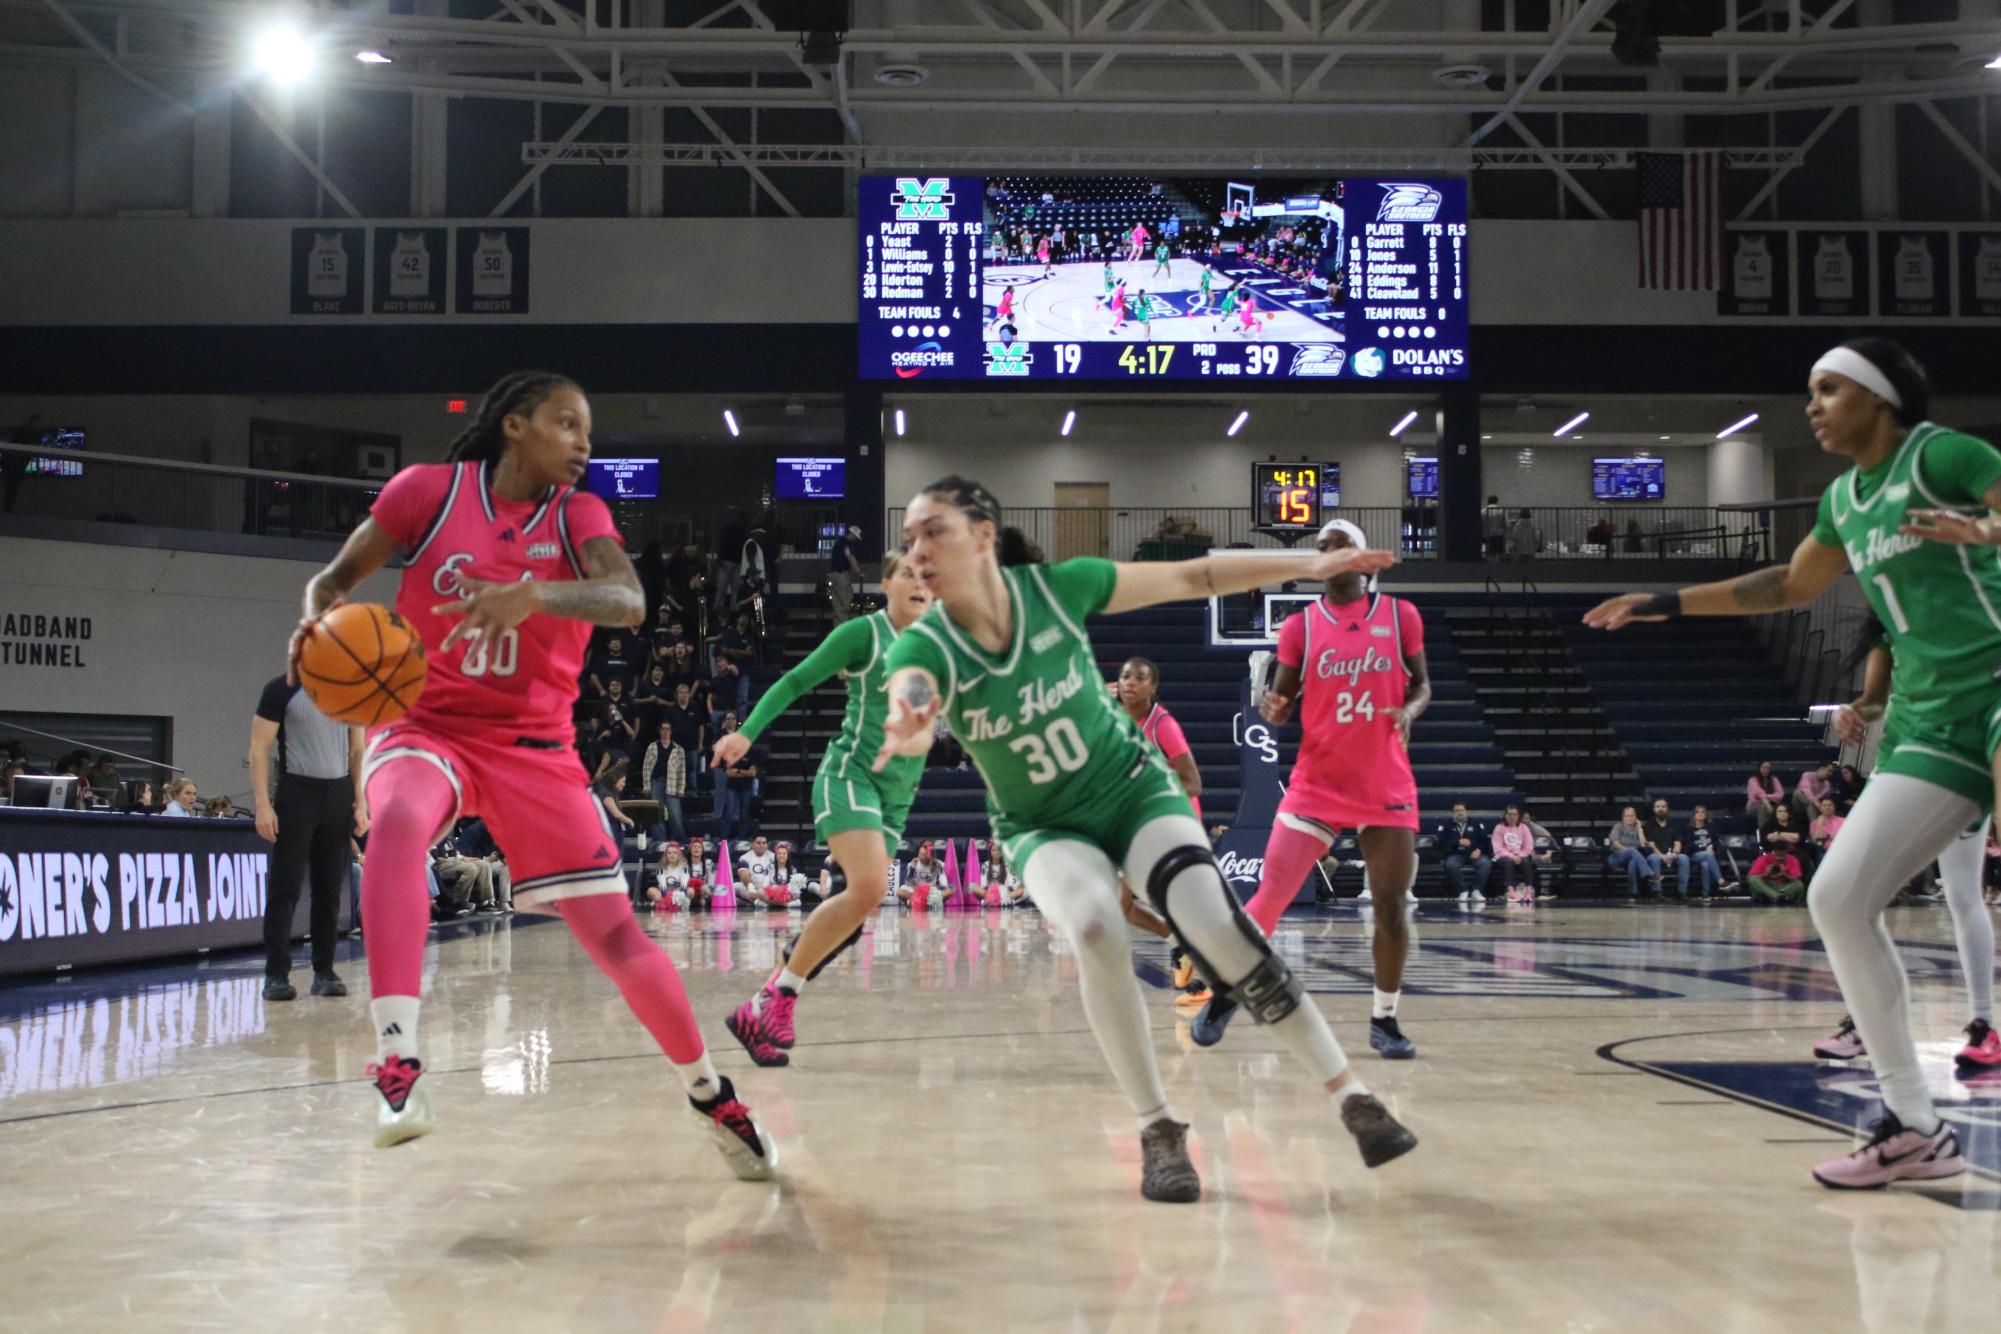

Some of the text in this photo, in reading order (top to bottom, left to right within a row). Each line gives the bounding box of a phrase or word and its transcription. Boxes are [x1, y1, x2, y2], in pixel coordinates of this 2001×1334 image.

[881, 223, 982, 235] PLAYER PTS FLS
[1366, 224, 1466, 236] PLAYER PTS FLS
[866, 236, 976, 247] 0 Yeast 2 1
[1351, 237, 1359, 248] 0
[1367, 237, 1404, 249] Garrett
[1453, 237, 1460, 248] 0
[868, 249, 873, 260] 1
[882, 248, 927, 260] Williams
[1350, 250, 1460, 261] 10 Jones 5 1
[321, 258, 335, 272] 15
[402, 257, 419, 271] 42
[484, 257, 501, 271] 50
[866, 262, 976, 275] 3 Lewis-Eutsey 10 1
[1349, 263, 1460, 274] 24 Anderson 11 1
[864, 274, 976, 286] 20 Ilderton 2 0
[1349, 276, 1361, 287] 30
[1367, 275, 1407, 289] Eddings
[1454, 276, 1460, 287] 1
[864, 287, 976, 298] 30 Redman 2 0
[1350, 288, 1461, 299] 41 Cleaveland 5 0
[473, 301, 511, 310] ROBERTS
[879, 307, 960, 319] TEAM FOULS 4
[1364, 308, 1446, 320] TEAM FOULS 0
[892, 352, 953, 362] OGEECHEE
[1192, 344, 1216, 356] PRD
[1392, 349, 1464, 365] DOLAN'S
[1053, 344, 1081, 373] 19
[1119, 345, 1175, 375] 4:17
[1245, 345, 1279, 374] 39
[1201, 361, 1240, 375] 2 POSS
[1274, 470, 1315, 488] 4:17
[1280, 489, 1310, 523] 15
[1872, 573, 1909, 634] 1
[0, 613, 91, 639] ADBAND
[2, 642, 86, 667] TUNNEL
[1317, 647, 1392, 686] Eagles
[962, 653, 1084, 742] The Herd
[1336, 690, 1375, 724] 24
[1008, 716, 1089, 785] 30
[119, 853, 200, 931] PIZZA
[207, 853, 268, 922] JOINT
